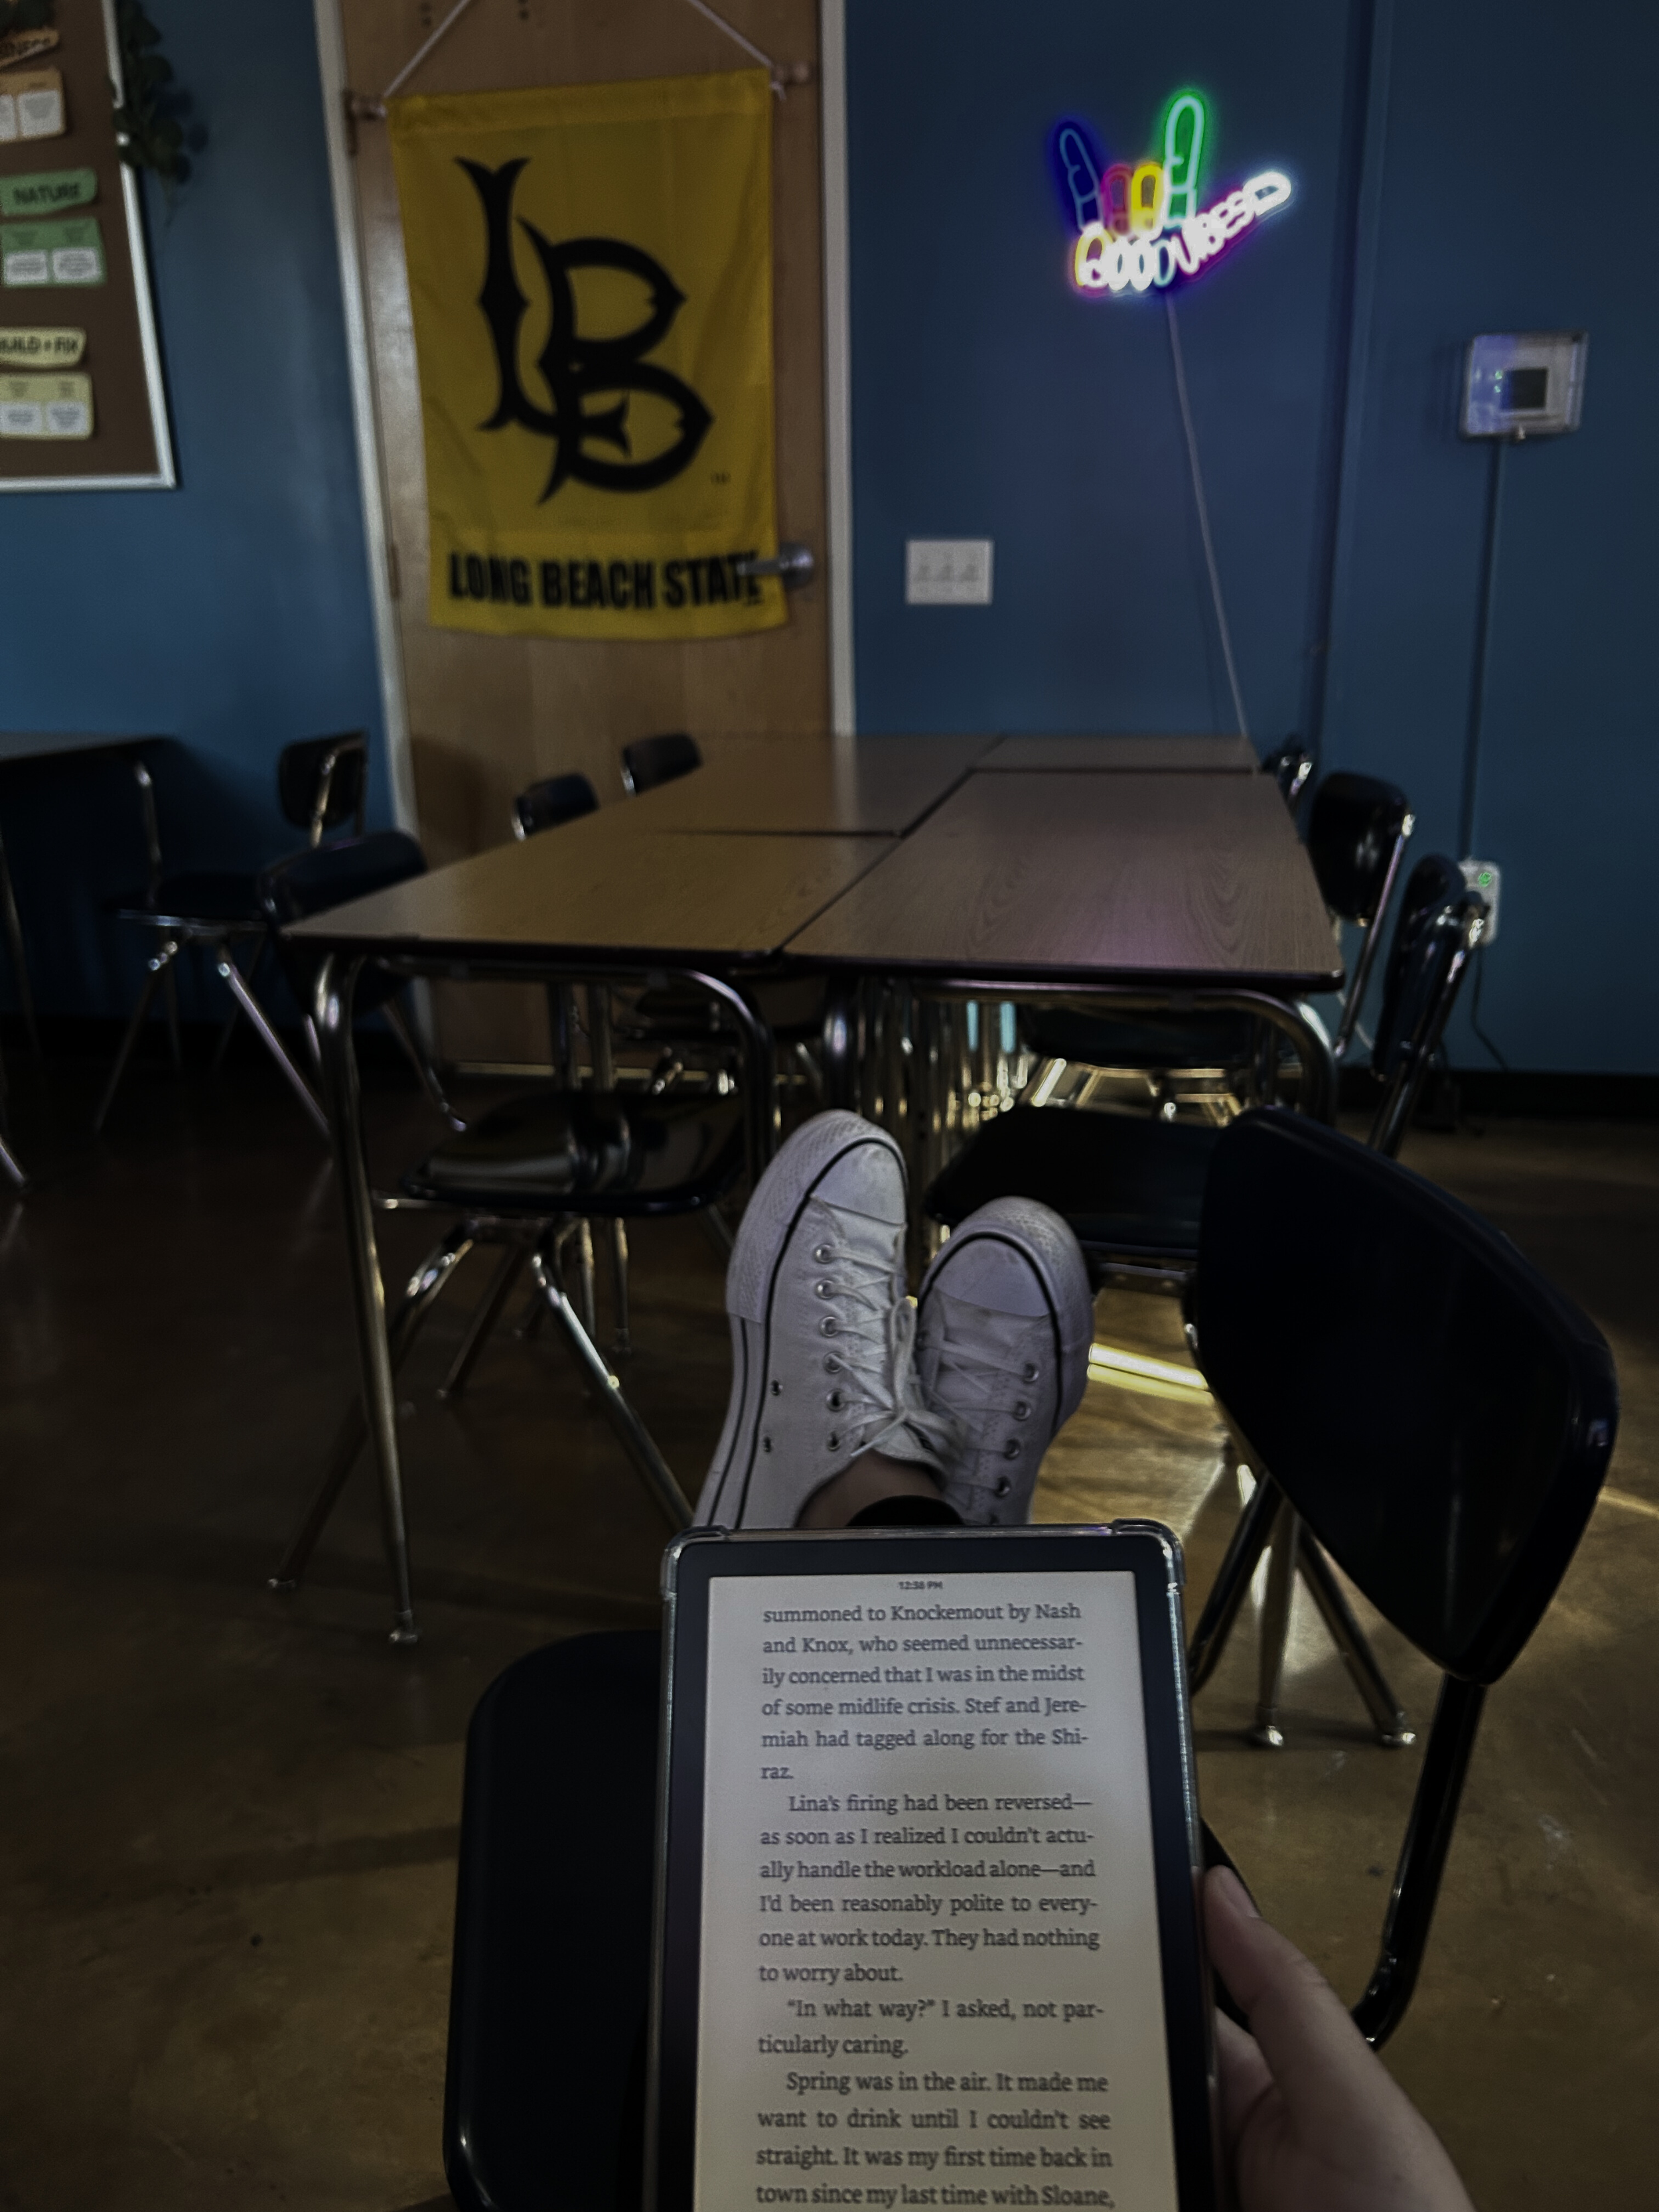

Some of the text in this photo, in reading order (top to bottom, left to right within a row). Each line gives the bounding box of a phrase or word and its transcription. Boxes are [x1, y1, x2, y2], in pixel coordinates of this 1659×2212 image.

[13, 181, 80, 206] NATURE
[449, 552, 532, 607] LONG
[540, 557, 656, 610] BEACH
[926, 1581, 943, 1589] PM
[763, 1602, 1082, 1623] summoned to Knockemout by Nash
[762, 1634, 1083, 1655] and Knox, who seemed unnecessar-
[762, 1664, 1086, 1688] ily concerned that I was in the midst
[761, 1696, 1087, 1717] of some midlife crisis. Stef and Jere-
[761, 1728, 1089, 1751] miah had tagged along for the Shi-
[760, 1767, 794, 1780] raz.
[788, 1795, 840, 1812] Lina's
[846, 1793, 899, 1816] firing
[903, 1794, 939, 1811] had
[944, 1793, 989, 1811] been
[760, 1826, 1095, 1845] as soon as I realized I couldn't actu-
[759, 1860, 794, 1883] ally
[797, 1860, 861, 1878] handle
[864, 1860, 895, 1878] the
[898, 1860, 987, 1878] workload
[759, 1893, 1098, 1917] I'd been reasonably polite to every-
[758, 1927, 1100, 1951] one at work today. They had nothing
[758, 1962, 903, 1986] to worry about.
[824, 1998, 872, 2018] what
[942, 2000, 950, 2018] I
[956, 1998, 1017, 2021] asked,
[1023, 2003, 1057, 2018] not
[1062, 2004, 1104, 2023] par-
[758, 2034, 908, 2059] ticularly caring.
[786, 2071, 1108, 2096] Spring was in the air. It made me
[757, 2108, 1110, 2130] want to drink until I couldn't see
[756, 2145, 1113, 2171] straight. It was my first time back in
[756, 2183, 1115, 2209] town since my last time with Sloane,
